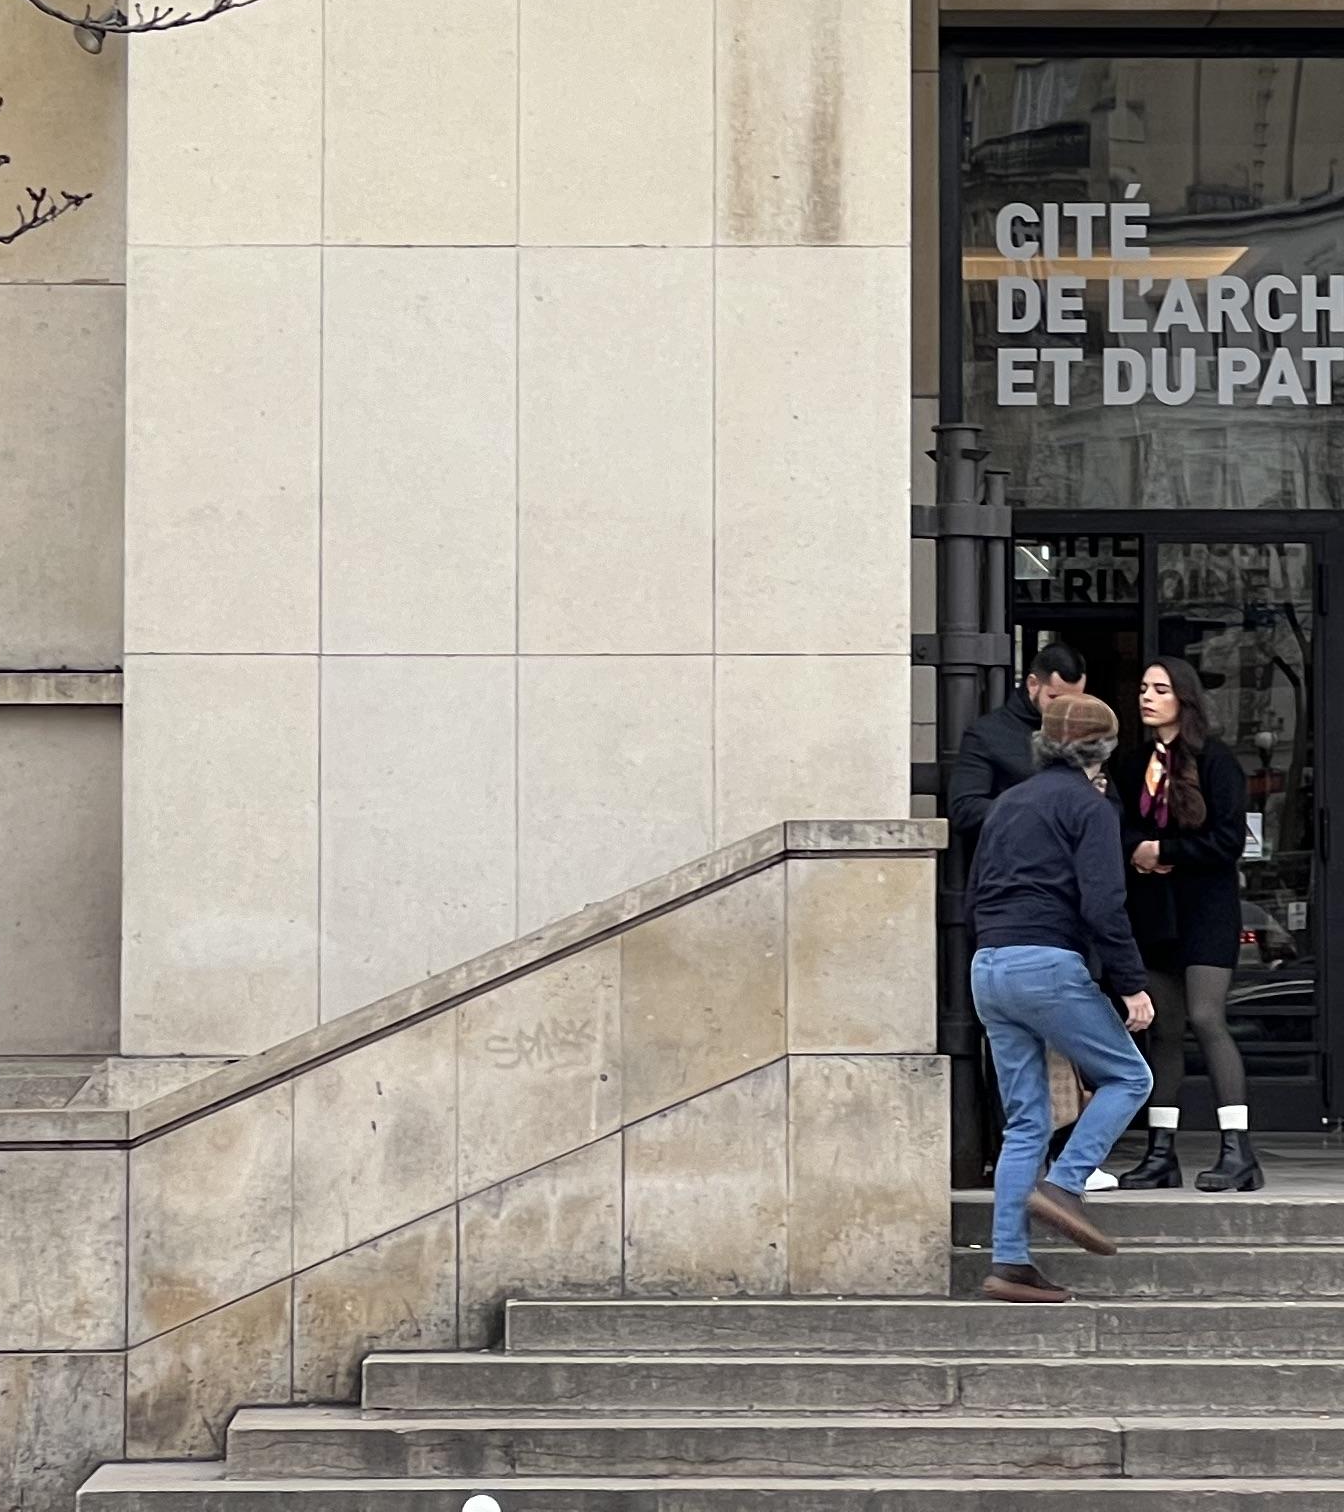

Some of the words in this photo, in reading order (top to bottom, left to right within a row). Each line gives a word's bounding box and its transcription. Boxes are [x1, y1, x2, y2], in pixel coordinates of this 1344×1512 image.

[995, 183, 1152, 261] CITÉ
[996, 276, 1088, 333] DE
[996, 348, 1083, 406] ET
[1103, 348, 1196, 405] DU
